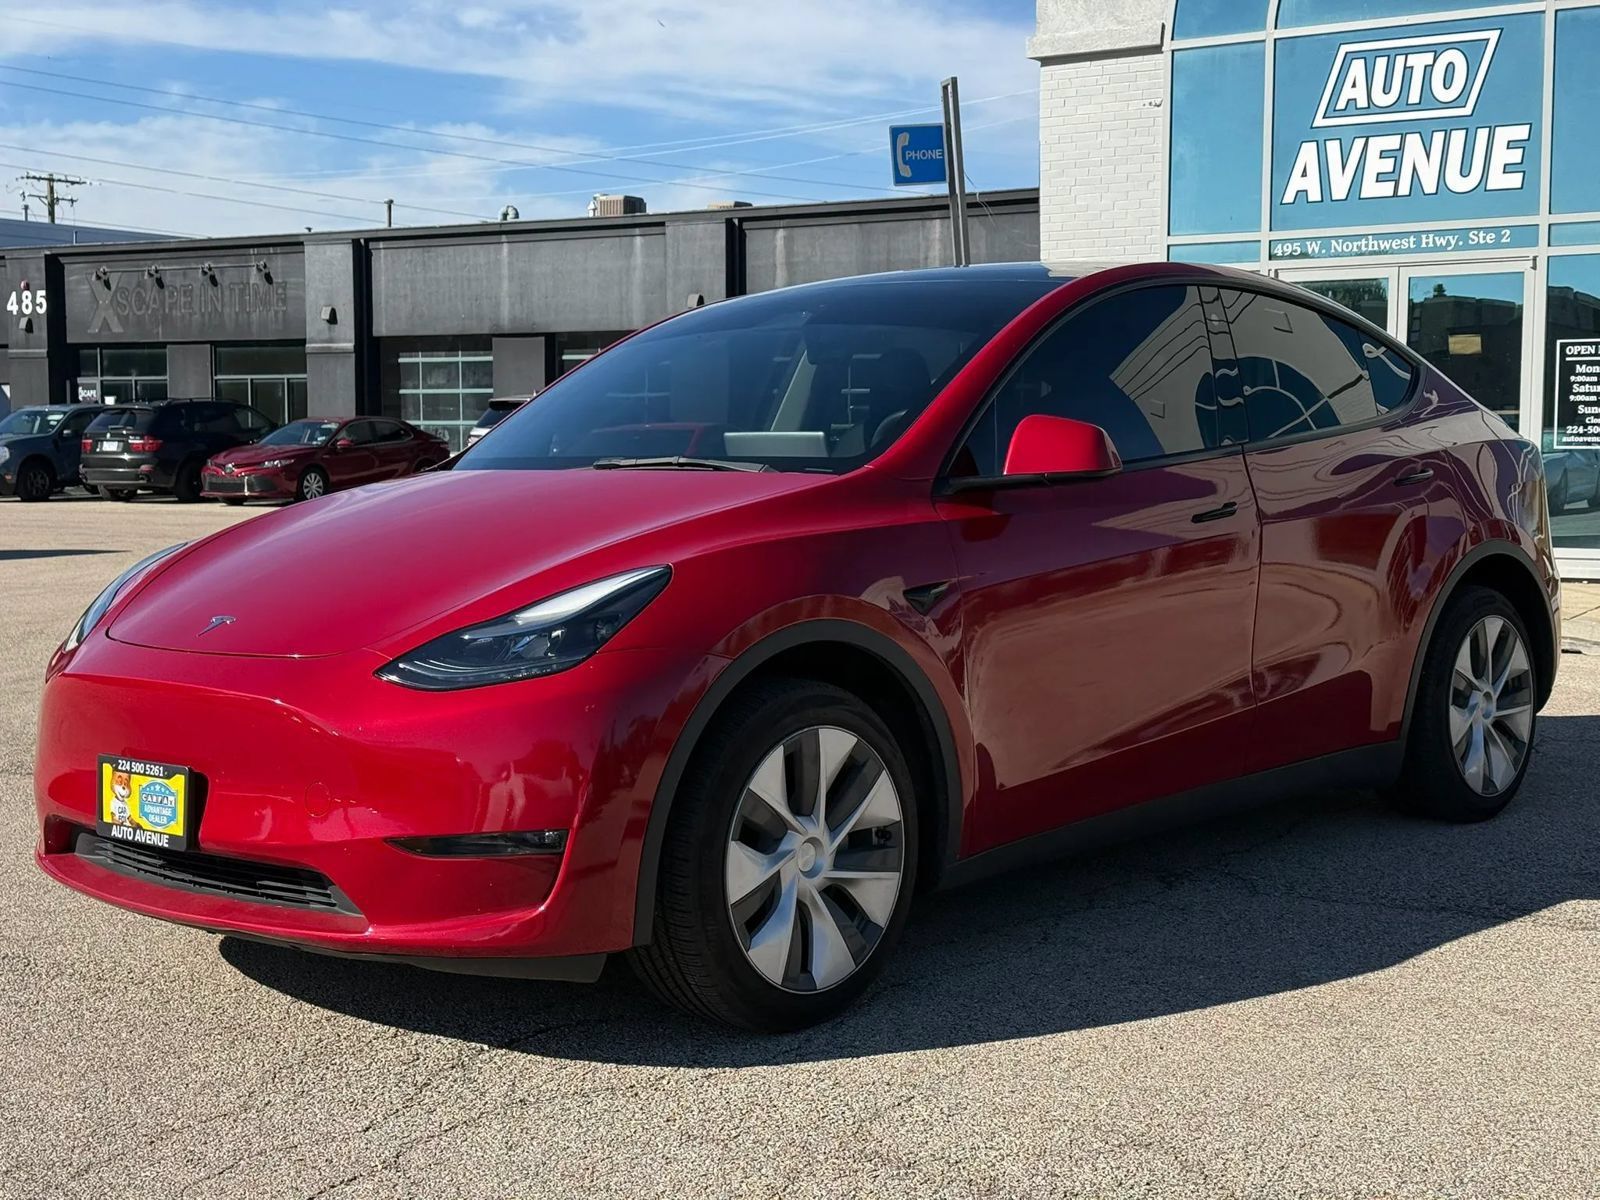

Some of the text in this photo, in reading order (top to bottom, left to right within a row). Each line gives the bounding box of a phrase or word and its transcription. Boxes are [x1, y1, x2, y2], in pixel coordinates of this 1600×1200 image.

[1334, 48, 1469, 112] AUTO
[905, 149, 943, 160] PHONE
[1280, 123, 1532, 205] AVENUE
[1273, 229, 1511, 257] 495 W. Northwest Hwy. Ste 2
[6, 290, 47, 315] 485
[229, 281, 287, 313] TIME
[1566, 345, 1595, 355] OPEN
[1577, 404, 1600, 414] Sun
[1566, 425, 1600, 434] 224-50
[118, 760, 164, 777] 224 500 5261
[144, 804, 172, 817] ADVANTAGE
[148, 813, 168, 824] DEALER
[111, 825, 169, 847] AUTO AVENUE
